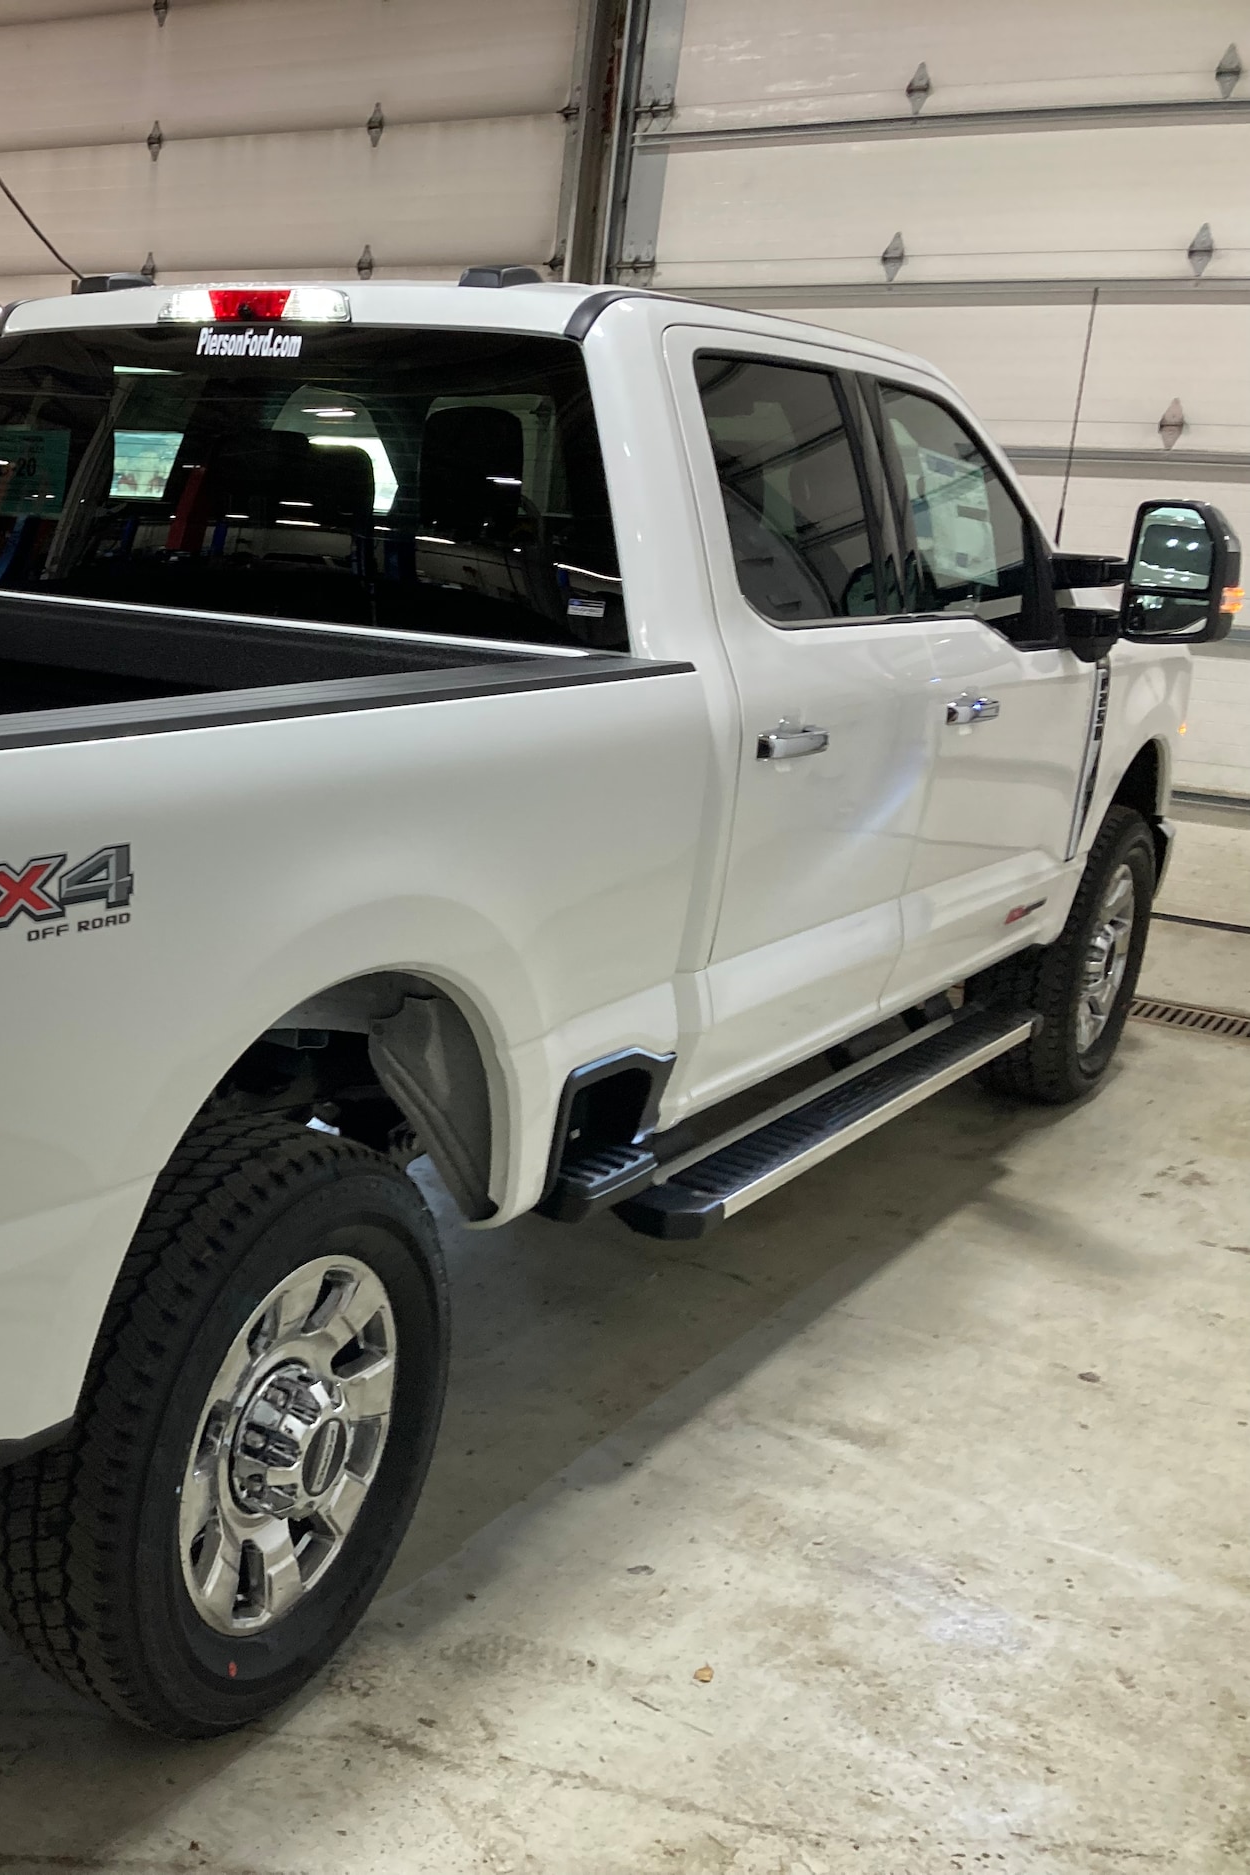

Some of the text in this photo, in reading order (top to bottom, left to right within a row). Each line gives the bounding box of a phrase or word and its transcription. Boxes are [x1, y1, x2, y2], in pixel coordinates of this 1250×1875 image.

[196, 327, 302, 357] PiersonFord.com
[26, 912, 131, 942] OFF ROAD
